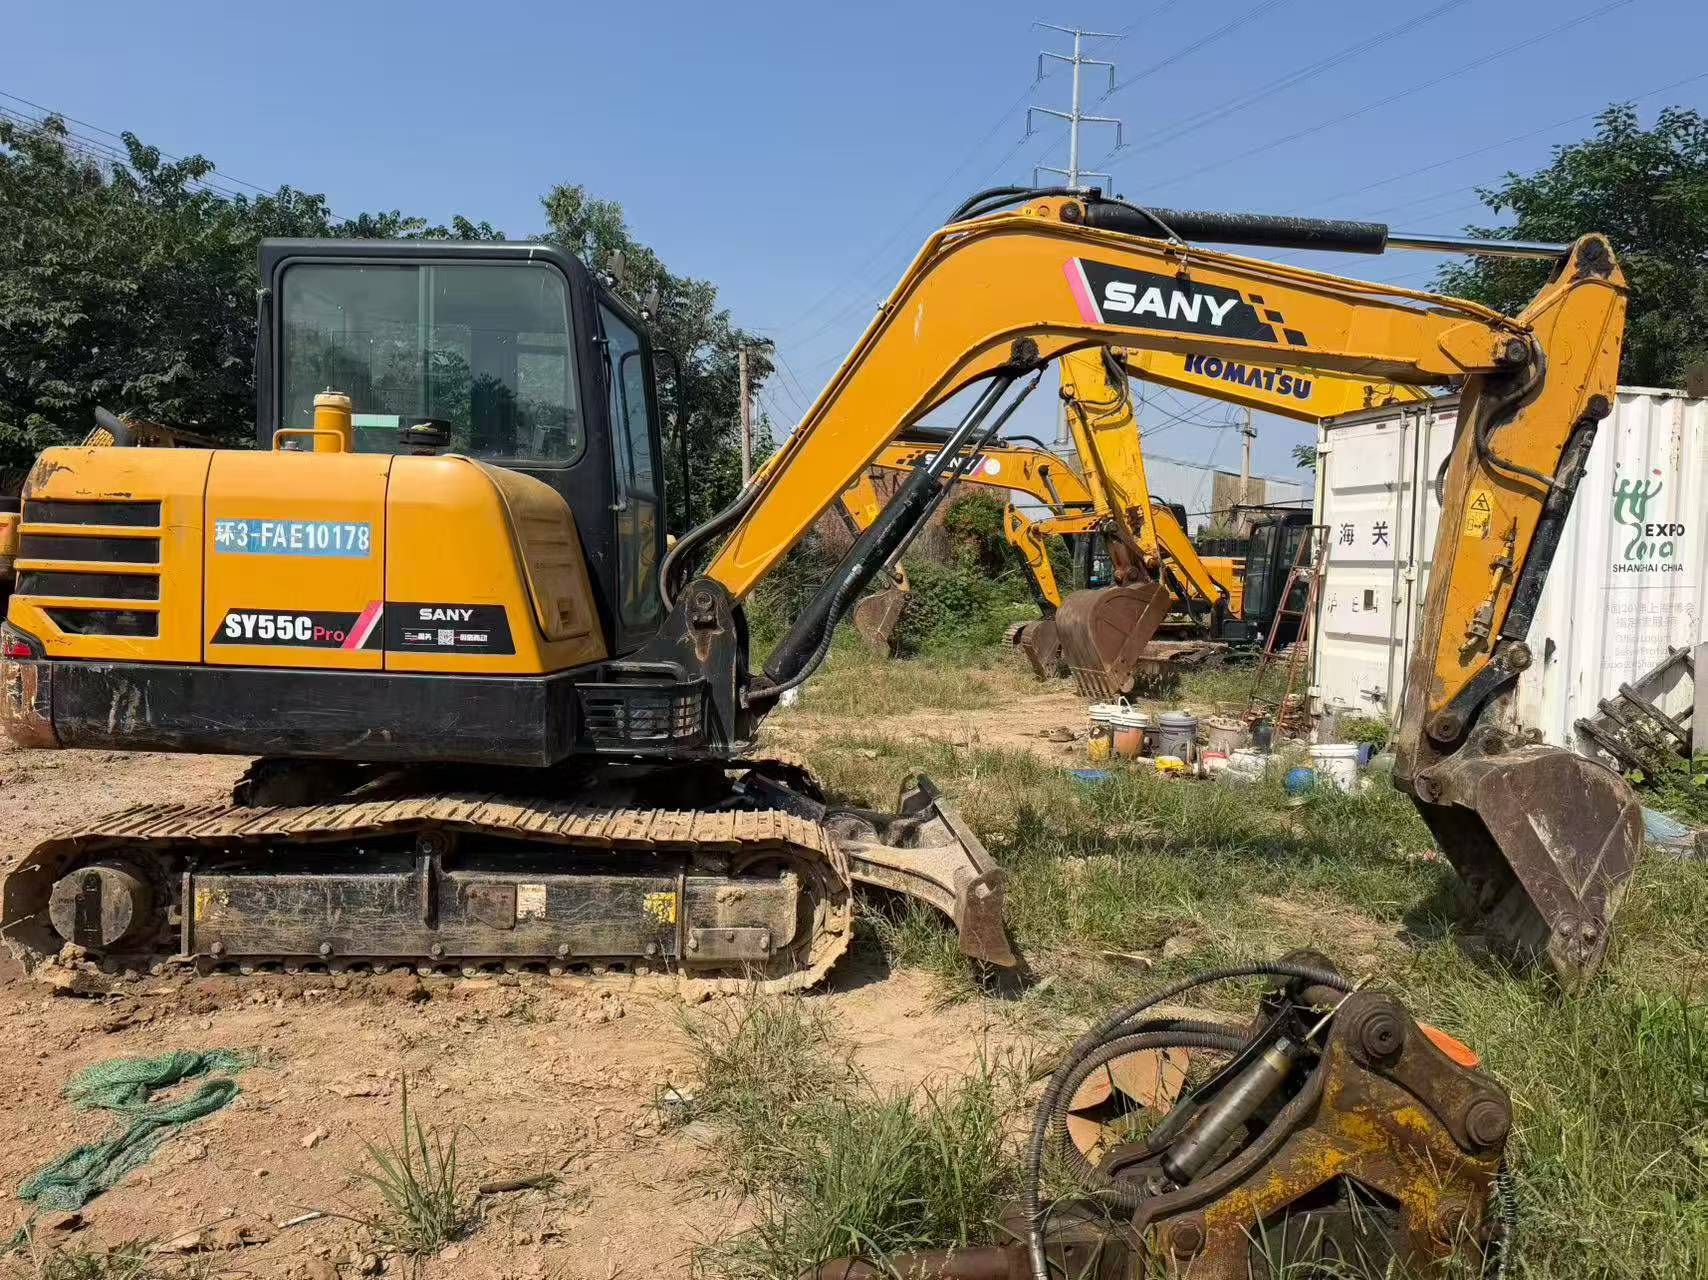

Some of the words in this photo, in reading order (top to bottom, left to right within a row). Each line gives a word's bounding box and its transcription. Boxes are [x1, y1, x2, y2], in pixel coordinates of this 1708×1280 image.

[1102, 280, 1239, 326] SANY
[1183, 353, 1312, 400] KOMATSU
[1339, 521, 1389, 546] 海关
[1645, 523, 1685, 537] EXPO
[225, 613, 312, 641] SY55C
[313, 626, 346, 642] Pro
[419, 608, 474, 622] SANY
